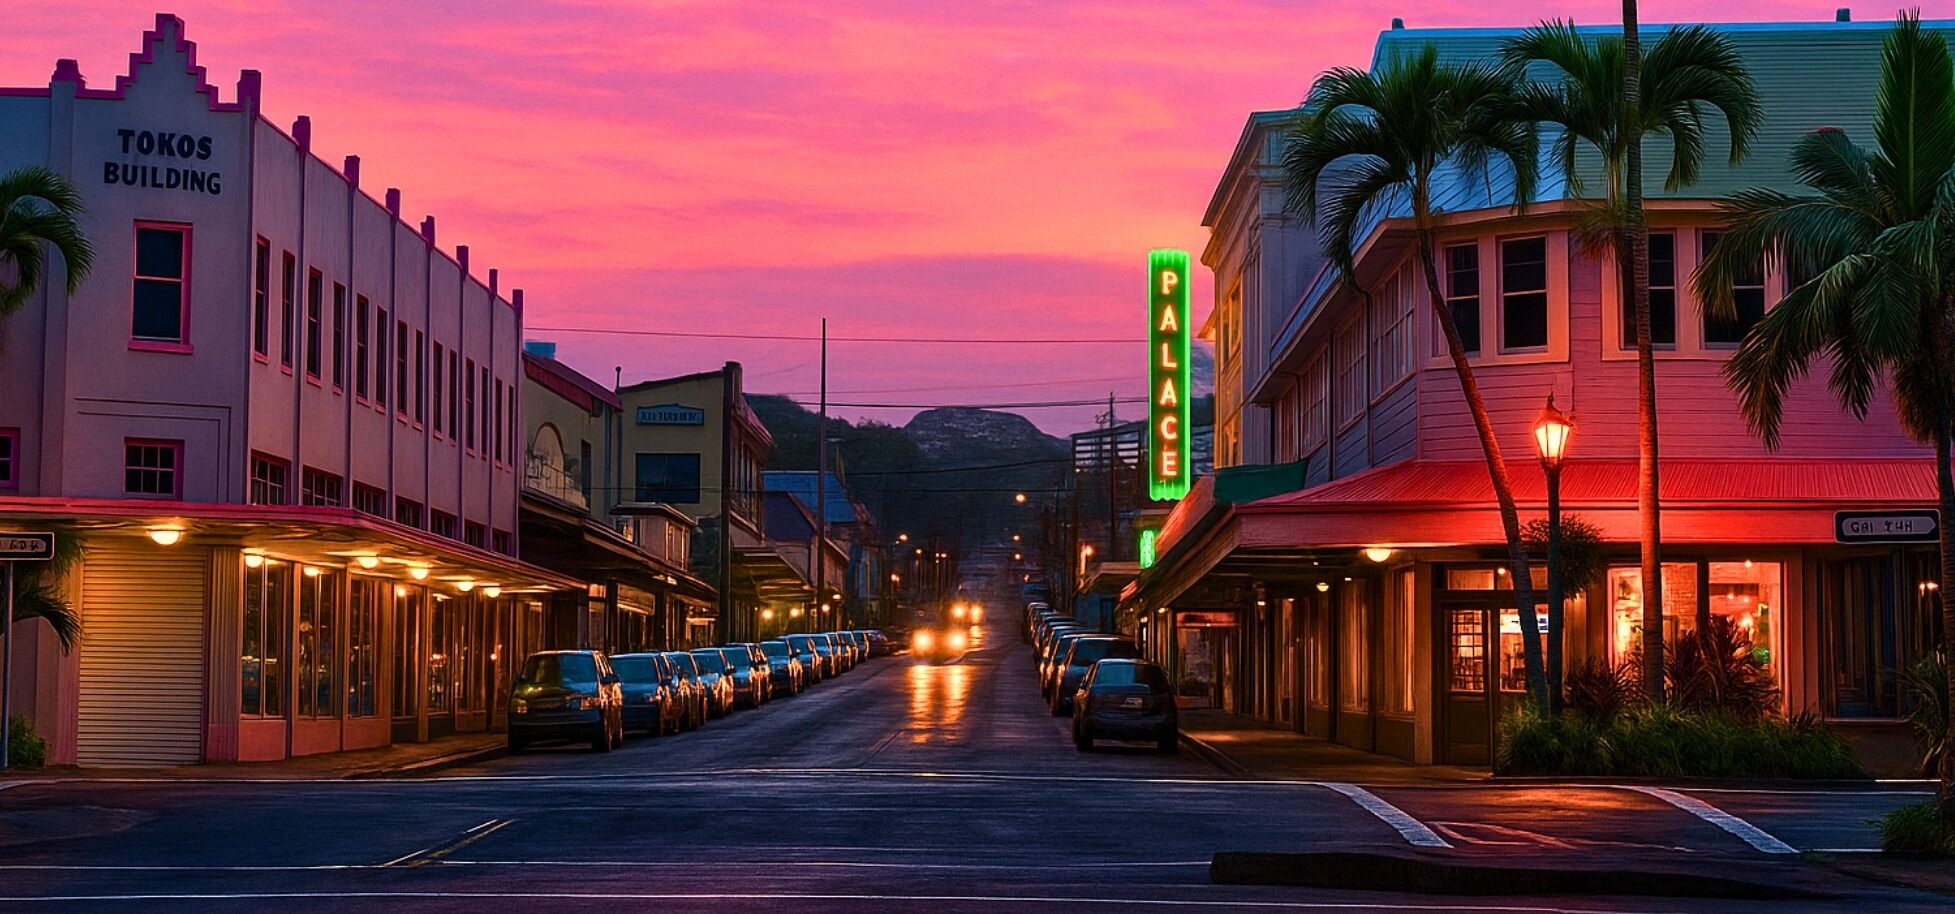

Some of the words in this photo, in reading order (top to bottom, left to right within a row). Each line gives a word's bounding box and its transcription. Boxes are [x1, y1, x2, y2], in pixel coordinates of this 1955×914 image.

[117, 128, 213, 160] TOKOS
[103, 161, 222, 195] BUILDING
[1159, 271, 1179, 477] PALACE
